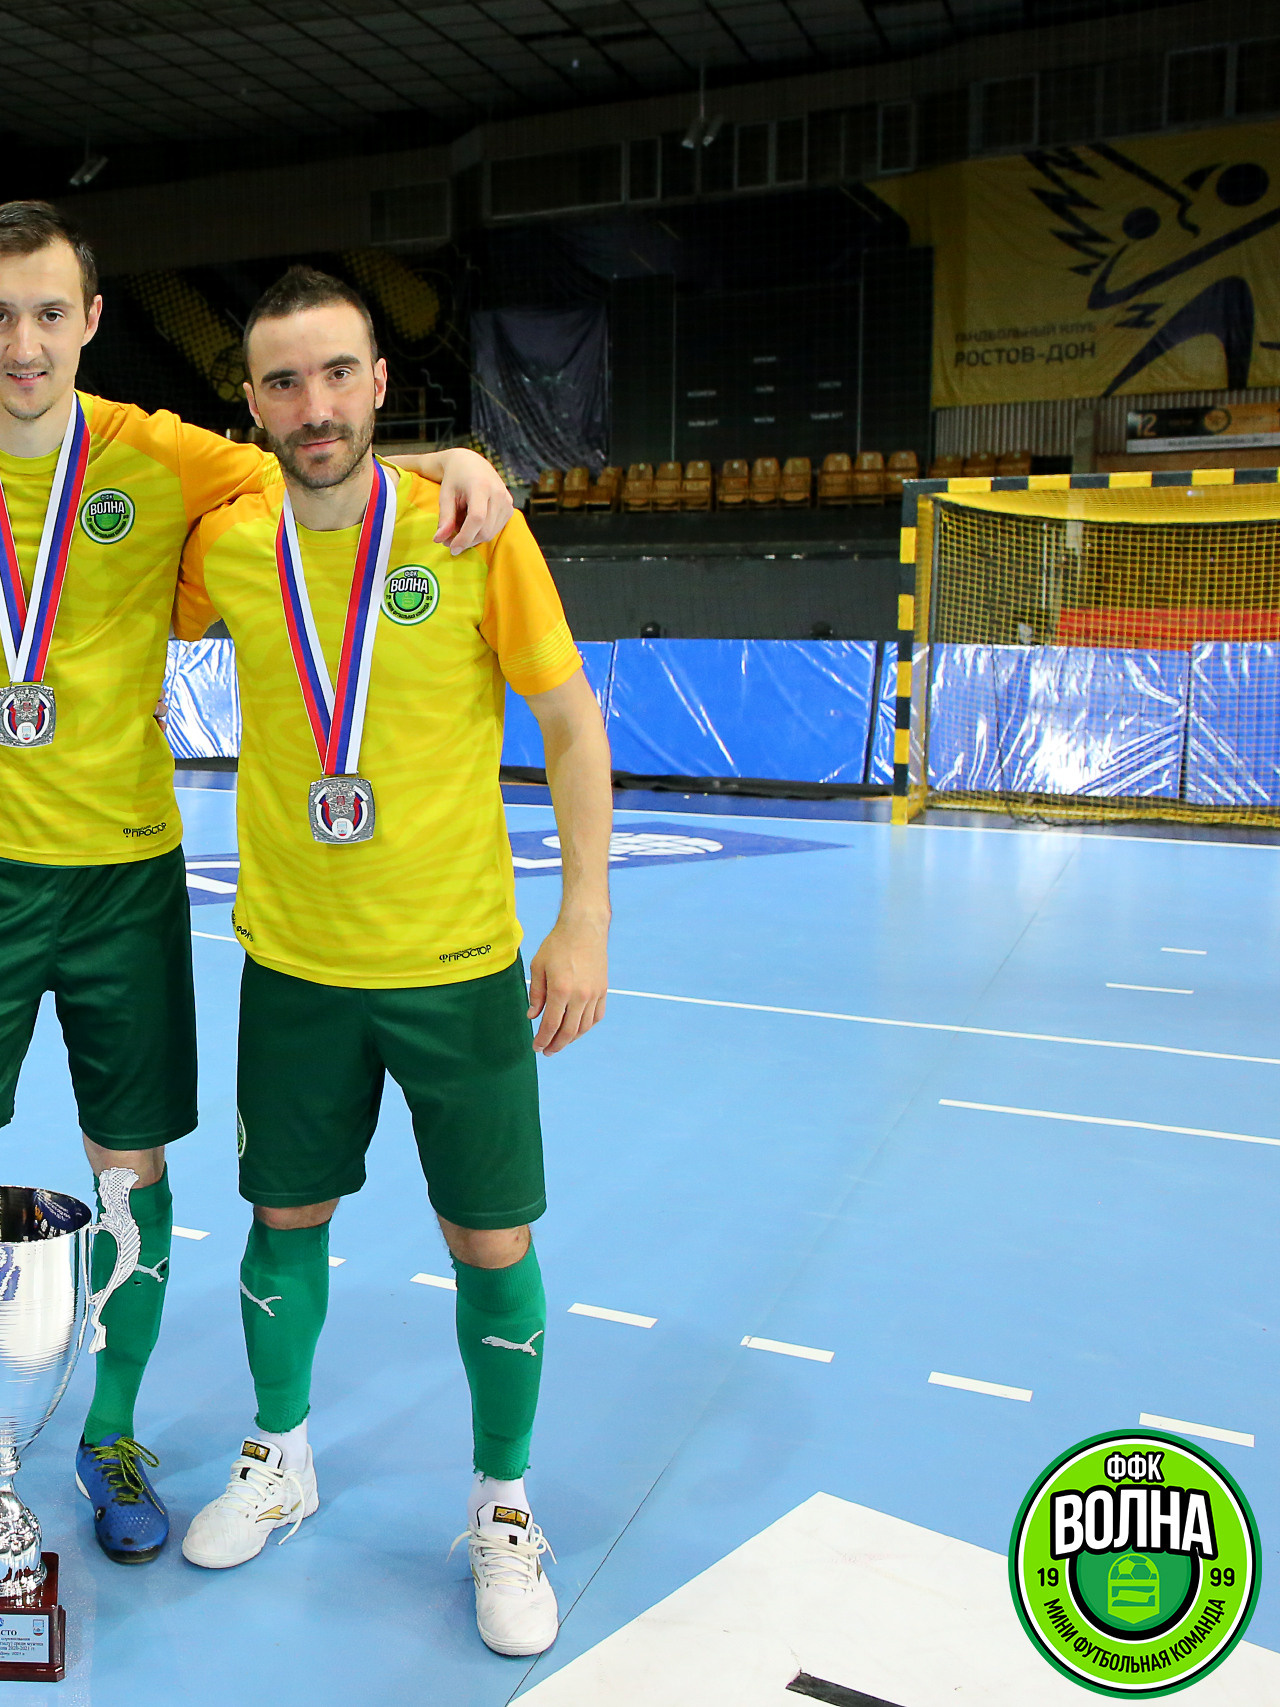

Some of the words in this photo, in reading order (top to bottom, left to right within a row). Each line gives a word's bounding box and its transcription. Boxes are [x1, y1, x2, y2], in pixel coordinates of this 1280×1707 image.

[954, 341, 1097, 368] РОСТОВ-ДОН
[90, 501, 125, 516] ВОЛНА
[390, 578, 429, 593] ВОЛНА
